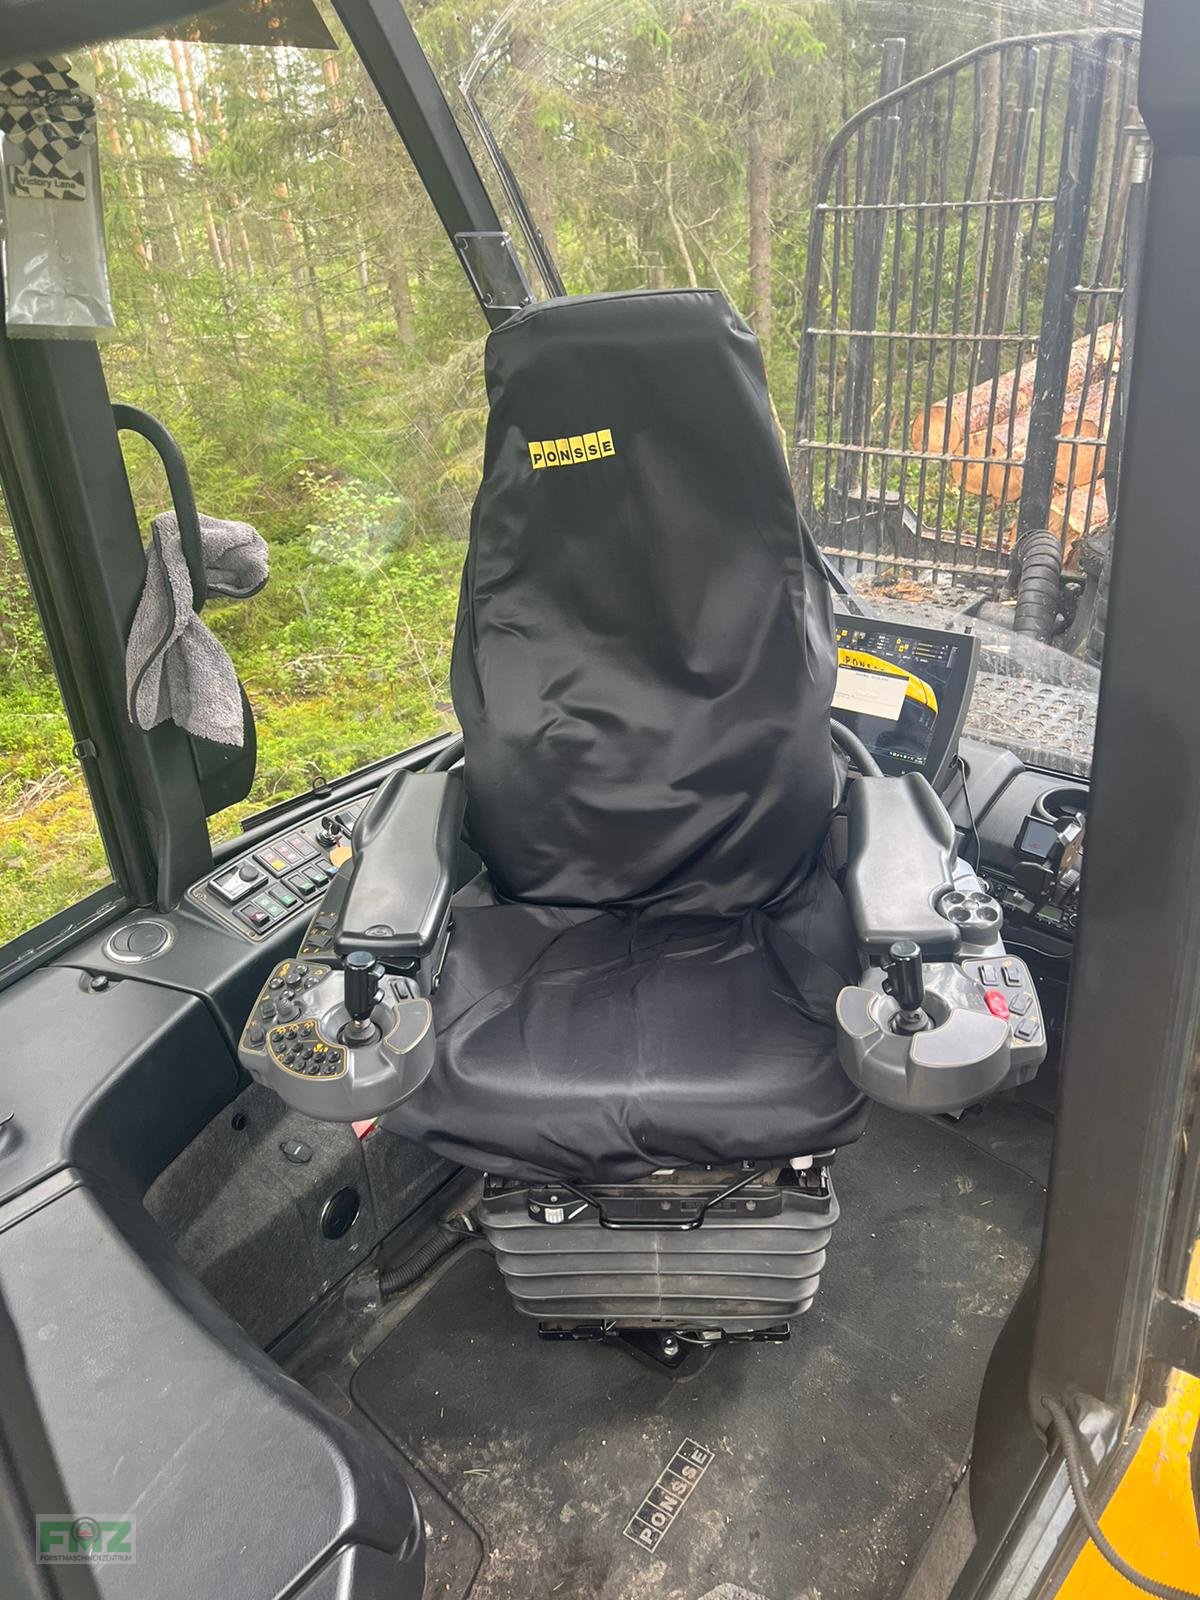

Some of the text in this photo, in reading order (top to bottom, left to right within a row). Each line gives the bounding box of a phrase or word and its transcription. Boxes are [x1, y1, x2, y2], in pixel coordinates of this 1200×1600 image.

[19, 175, 76, 190] Victory Lane
[532, 441, 613, 465] PONSSE
[639, 1449, 708, 1545] PONSSE
